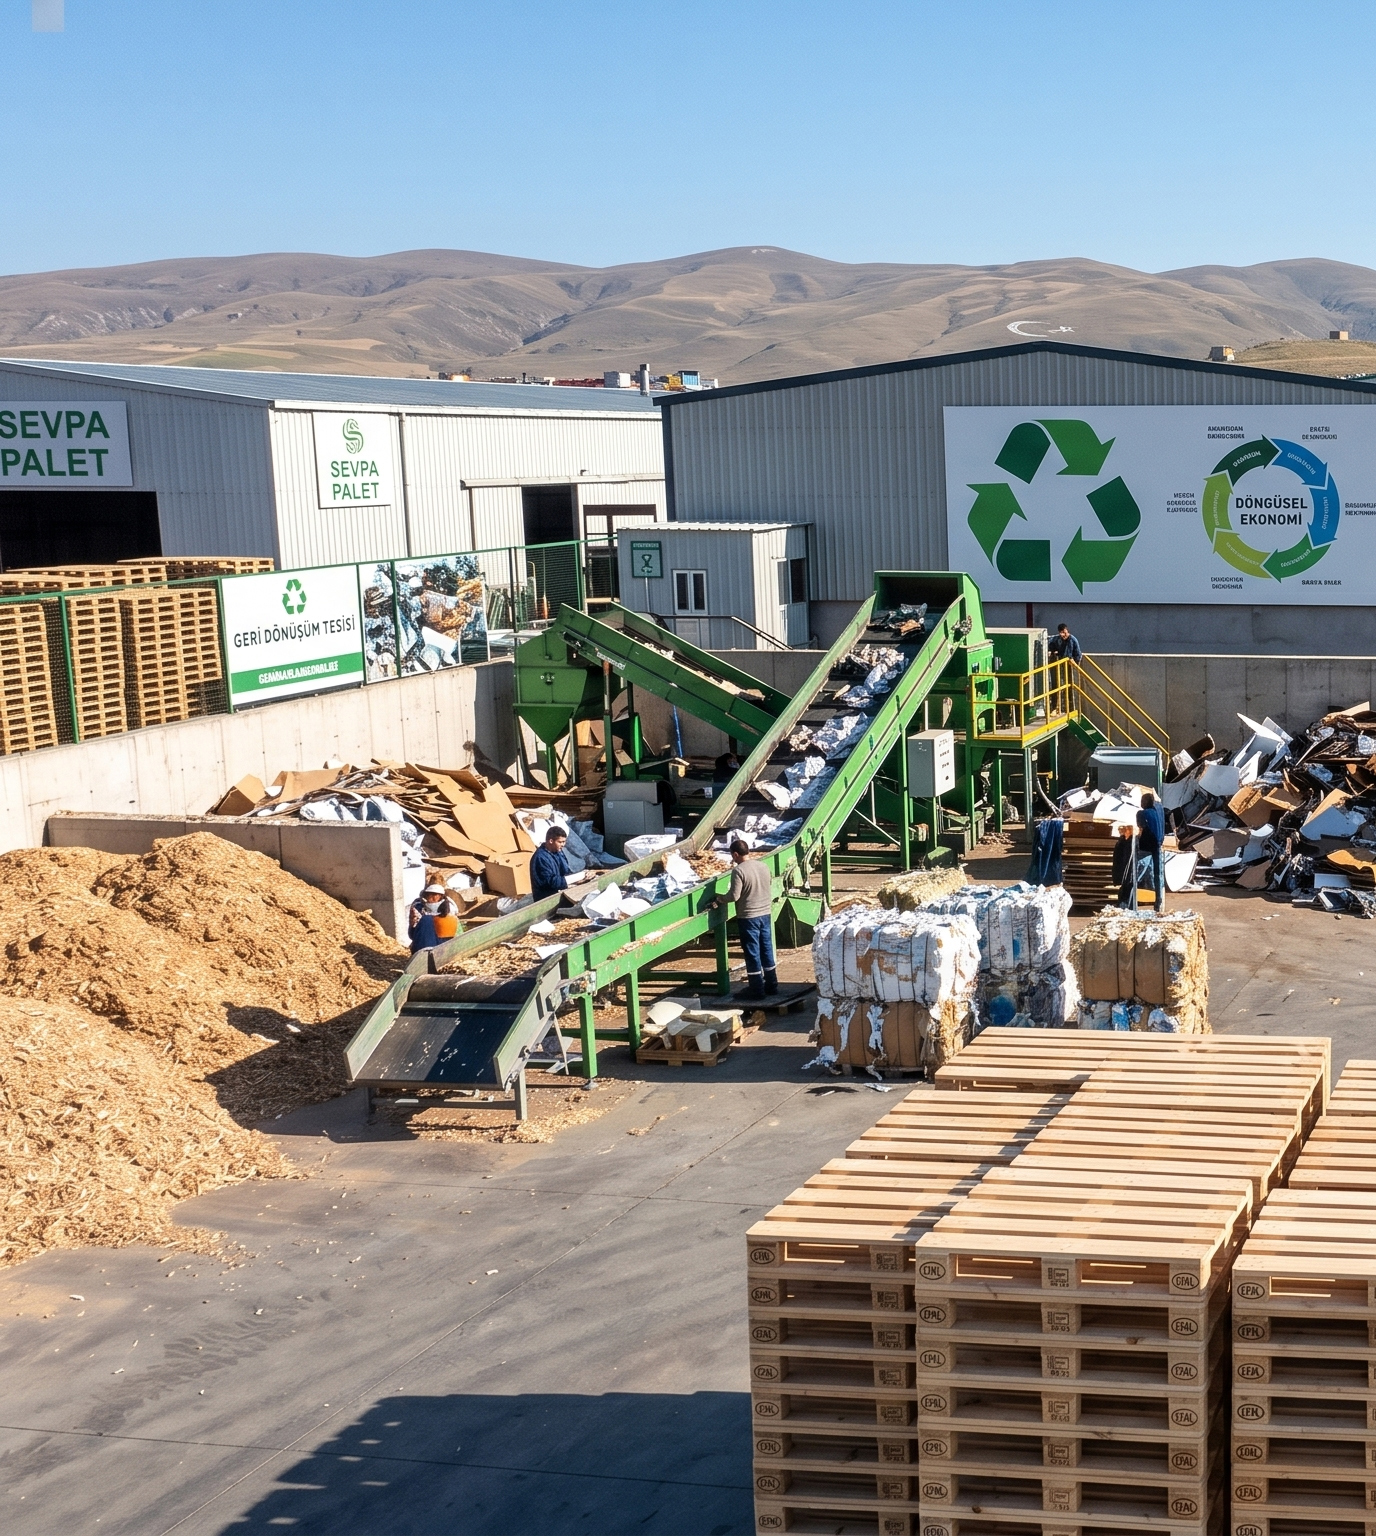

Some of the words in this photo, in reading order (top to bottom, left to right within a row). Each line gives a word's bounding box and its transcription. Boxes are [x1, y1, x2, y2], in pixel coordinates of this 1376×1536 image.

[0, 410, 110, 439] SEVPA
[1, 448, 109, 476] PALET
[331, 460, 379, 478] SEVPA
[332, 482, 379, 500] PALET
[1235, 494, 1308, 509] DÖNGÜSEL
[1240, 511, 1302, 525] EKONOMİ
[233, 626, 262, 648] GERİ
